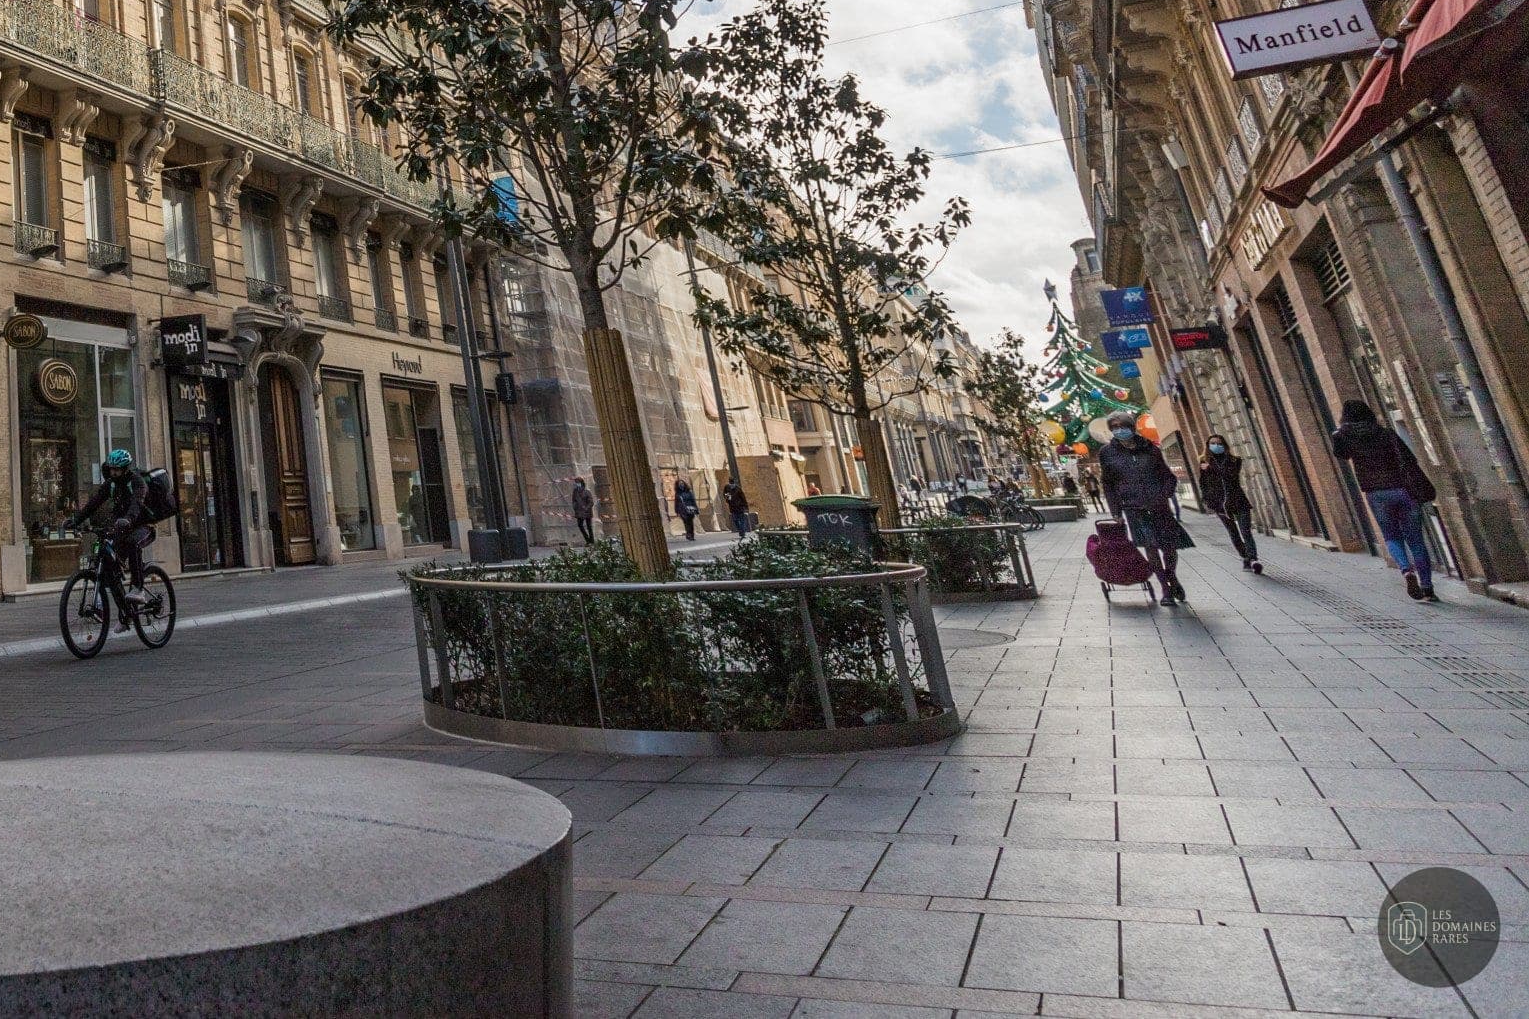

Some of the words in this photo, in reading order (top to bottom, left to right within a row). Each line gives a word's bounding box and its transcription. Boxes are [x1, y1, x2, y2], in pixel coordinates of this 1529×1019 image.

[1233, 14, 1365, 55] Manfield
[163, 324, 202, 345] modi
[185, 341, 199, 355] in
